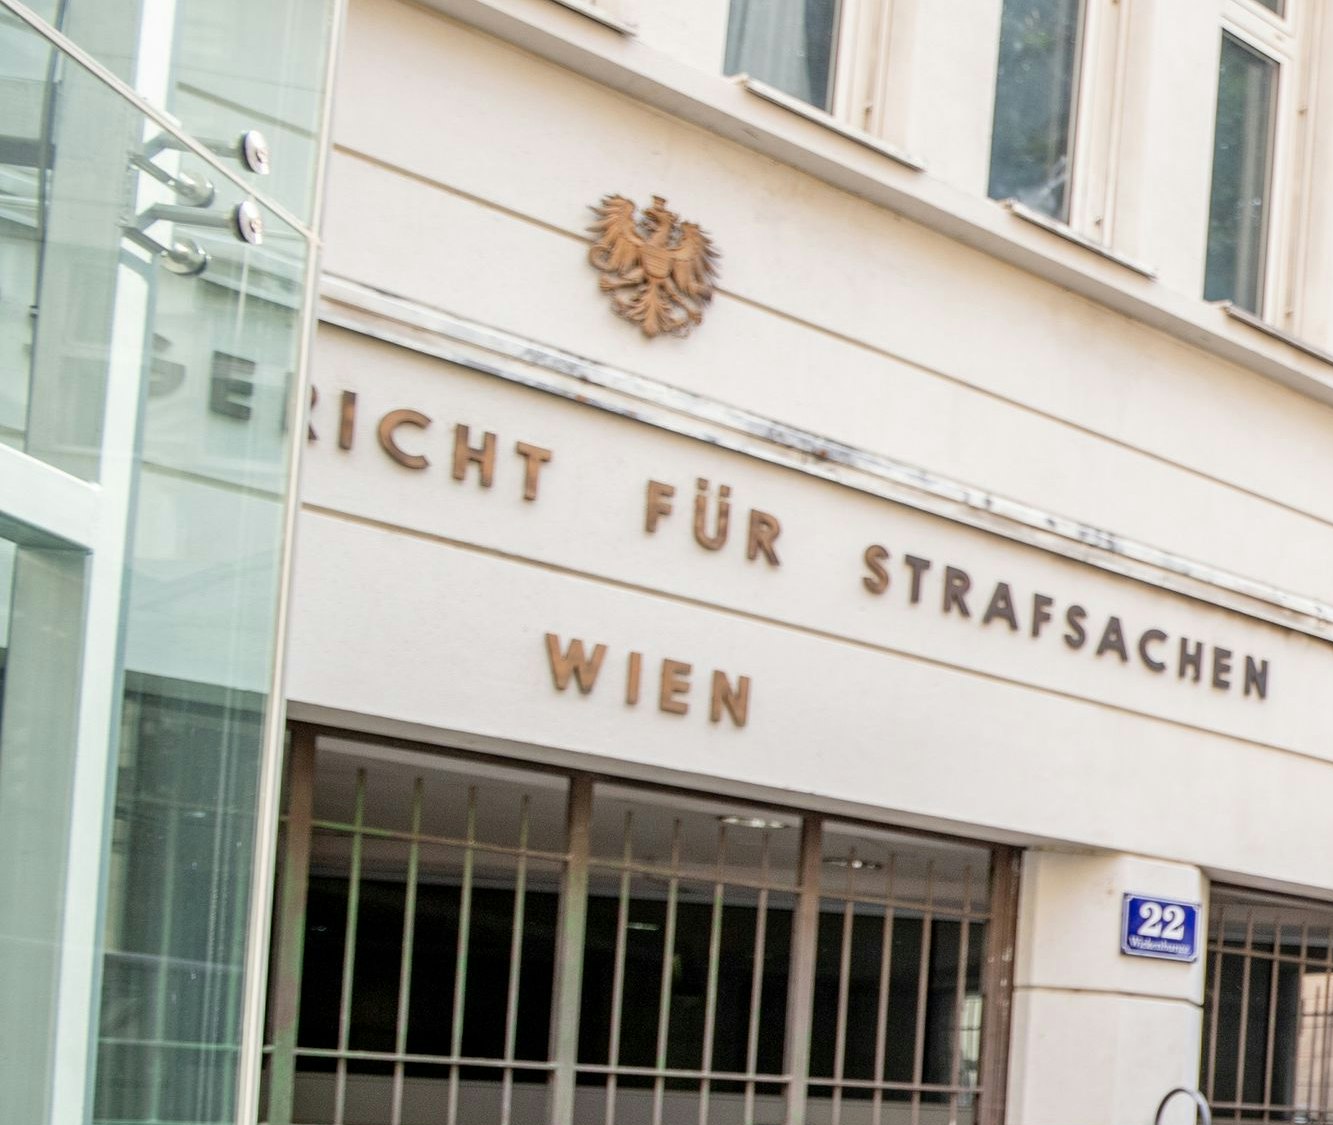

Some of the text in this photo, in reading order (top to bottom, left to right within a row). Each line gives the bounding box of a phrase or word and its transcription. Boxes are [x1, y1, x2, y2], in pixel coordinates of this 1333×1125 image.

[645, 477, 783, 567] FÜR
[861, 544, 1271, 701] STRAFSACHEN
[545, 632, 752, 728] WIEN
[1137, 901, 1185, 941] 22
